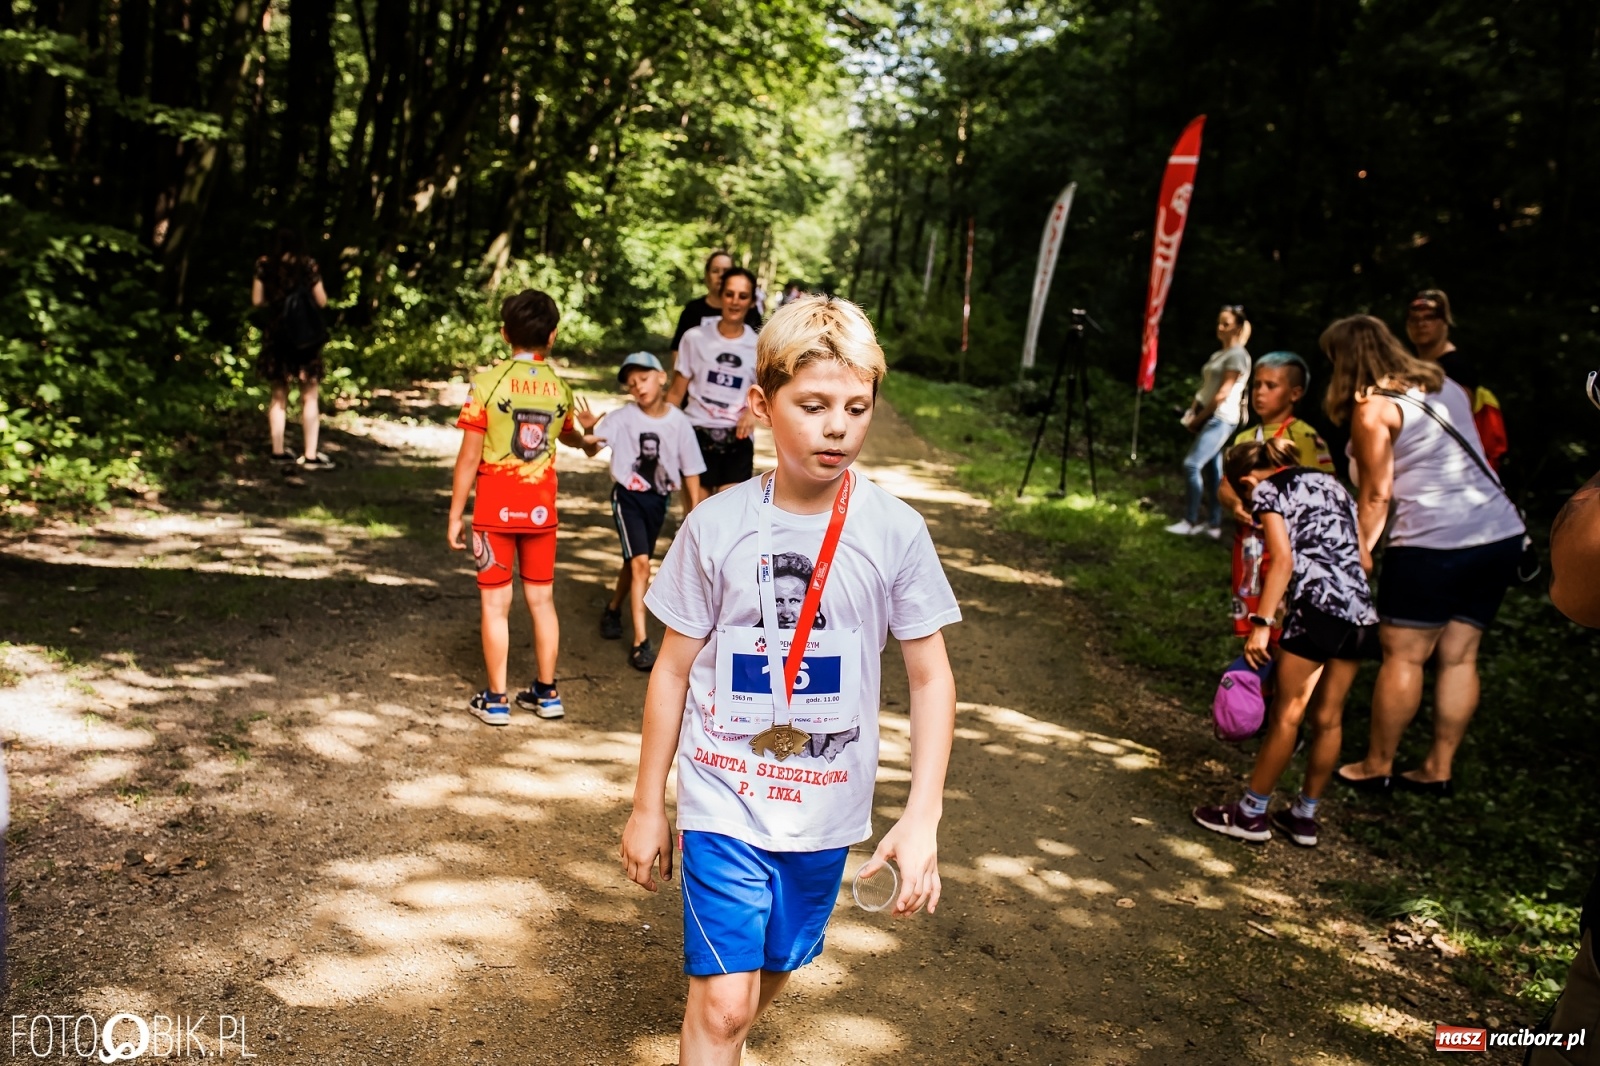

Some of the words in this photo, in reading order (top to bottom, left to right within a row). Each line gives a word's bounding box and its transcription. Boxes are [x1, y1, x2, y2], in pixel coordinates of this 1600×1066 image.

[732, 694, 746, 702] 1963
[805, 695, 823, 704] godz.
[824, 694, 840, 703] 11.00
[694, 747, 748, 774] DANUTA
[756, 763, 848, 787] SIEDZIKÓWNA
[737, 781, 755, 798] P.
[766, 786, 803, 803] INKA
